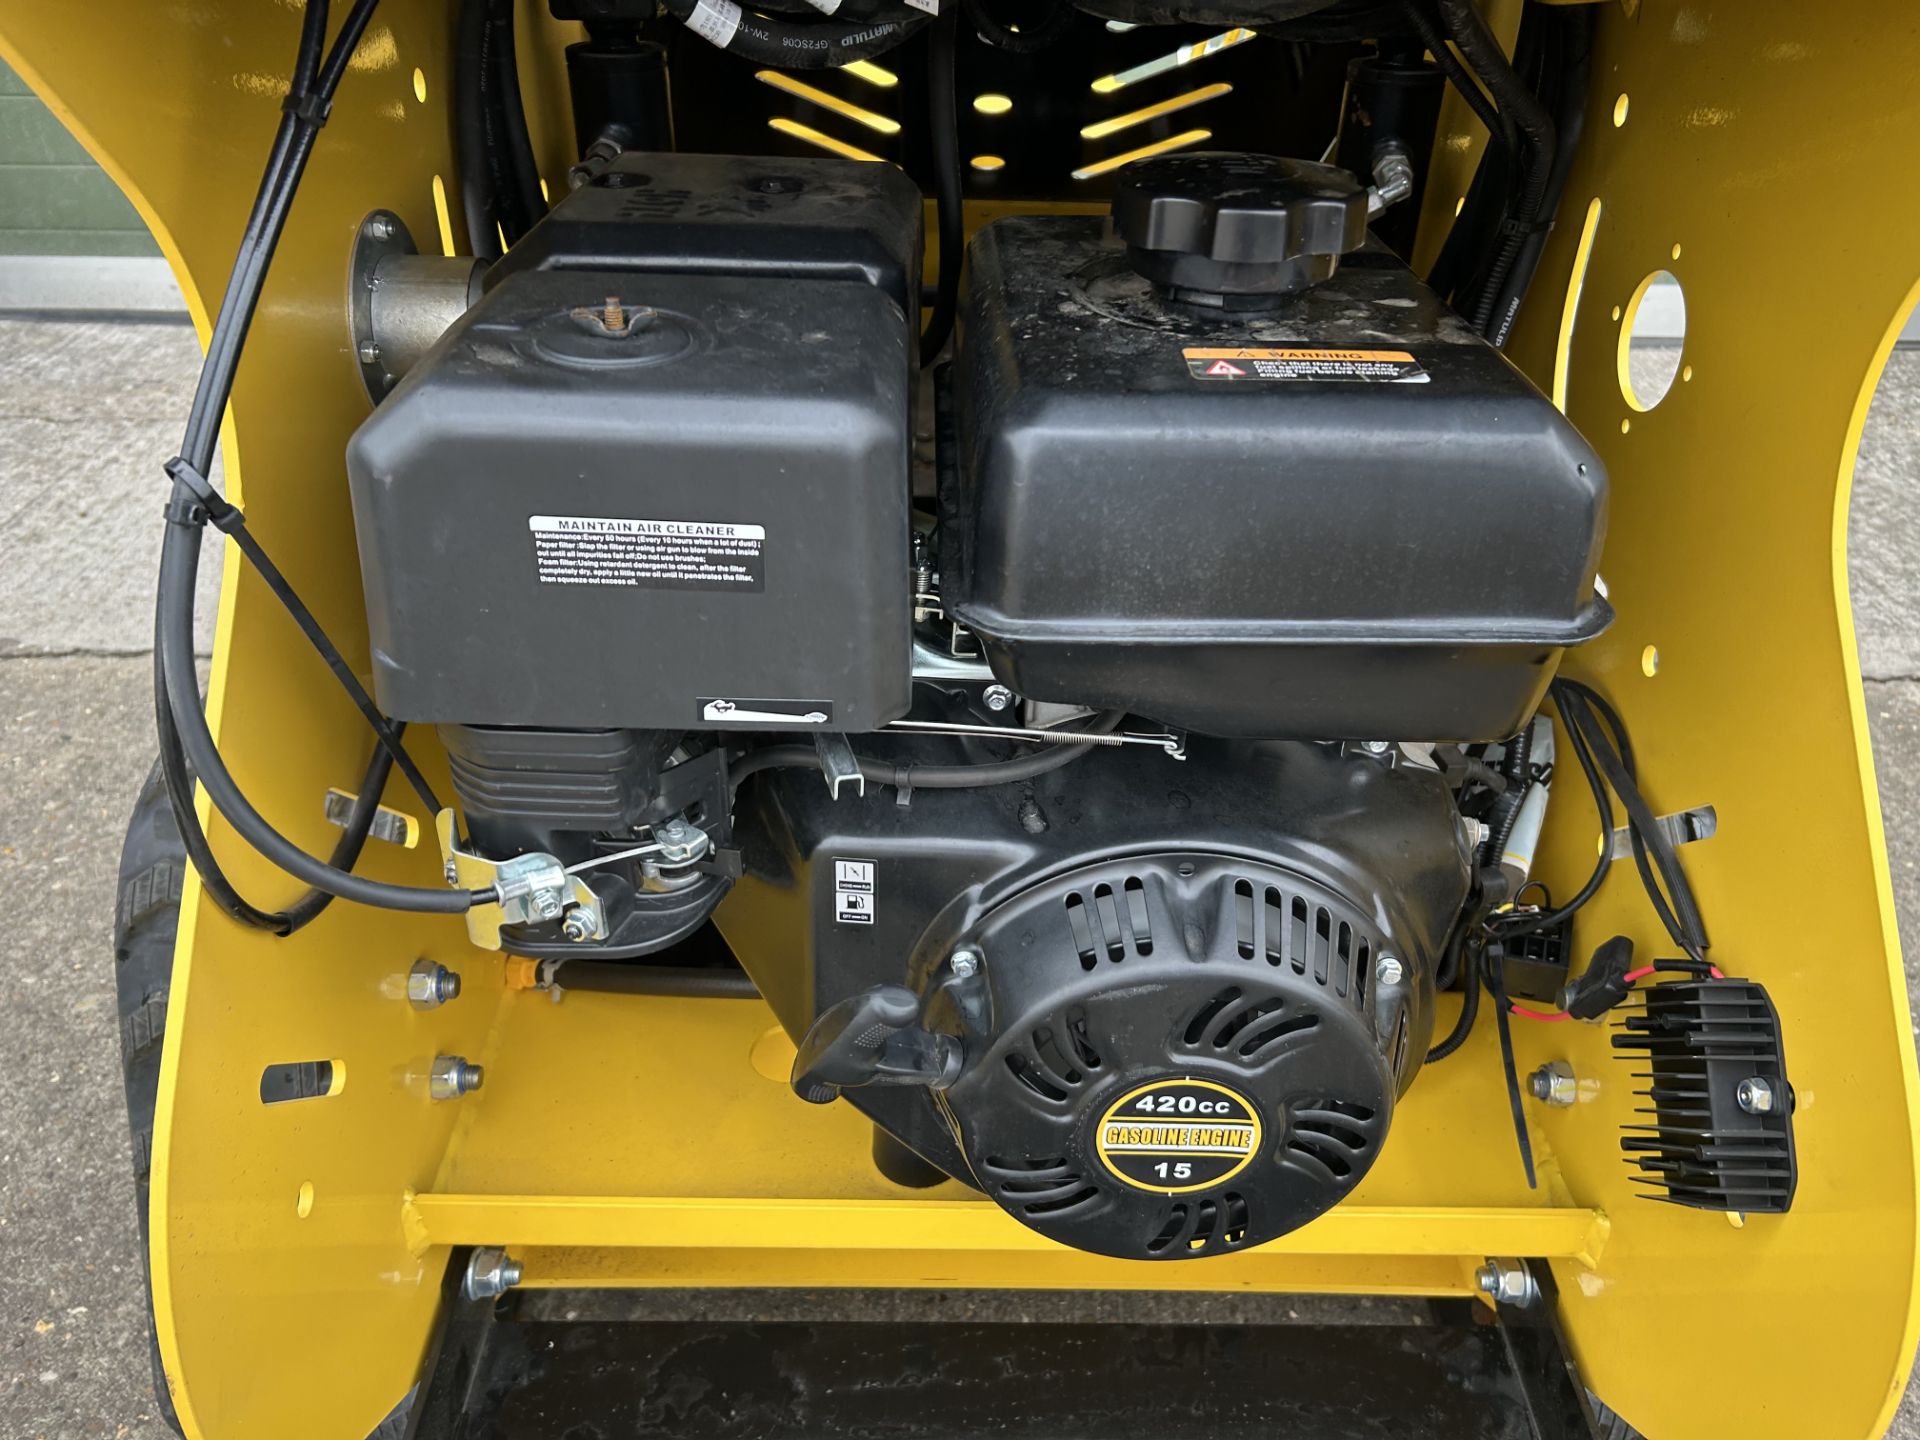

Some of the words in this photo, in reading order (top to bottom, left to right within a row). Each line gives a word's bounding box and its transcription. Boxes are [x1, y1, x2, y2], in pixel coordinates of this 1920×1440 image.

[841, 23, 899, 47] MATULIP
[782, 36, 829, 50] GF2SC06
[1495, 296, 1520, 347] MATULIP
[1268, 351, 1362, 359] WARNING
[558, 520, 632, 532] MAINTAIN
[637, 523, 662, 533] AIR
[666, 524, 735, 536] CLEANER
[536, 541, 558, 549] Paper
[609, 543, 626, 551] filter
[635, 545, 655, 553] using
[708, 547, 725, 555] from
[725, 548, 737, 556] the
[637, 536, 661, 544] (Every
[672, 537, 693, 545] hours
[694, 538, 714, 546] when
[730, 539, 738, 547] of
[576, 551, 612, 559] impurities
[613, 551, 625, 559] fall
[538, 558, 559, 566] Foam
[600, 560, 633, 568] retardant
[633, 561, 668, 570] detergent
[677, 563, 699, 572] clean,
[700, 564, 716, 572] after
[729, 565, 746, 573] filter
[539, 567, 578, 576] completely
[593, 569, 613, 577] apply
[620, 569, 636, 577] little
[652, 570, 662, 578] oil
[684, 572, 722, 581] penetrates
[723, 573, 735, 581] the
[540, 575, 556, 583] then
[557, 576, 588, 584] squeeze
[1135, 1095, 1231, 1113] 420cc
[1106, 1126, 1188, 1146] GASOLINE
[1189, 1128, 1251, 1148] ENGINE
[1154, 1162, 1192, 1178] 15
